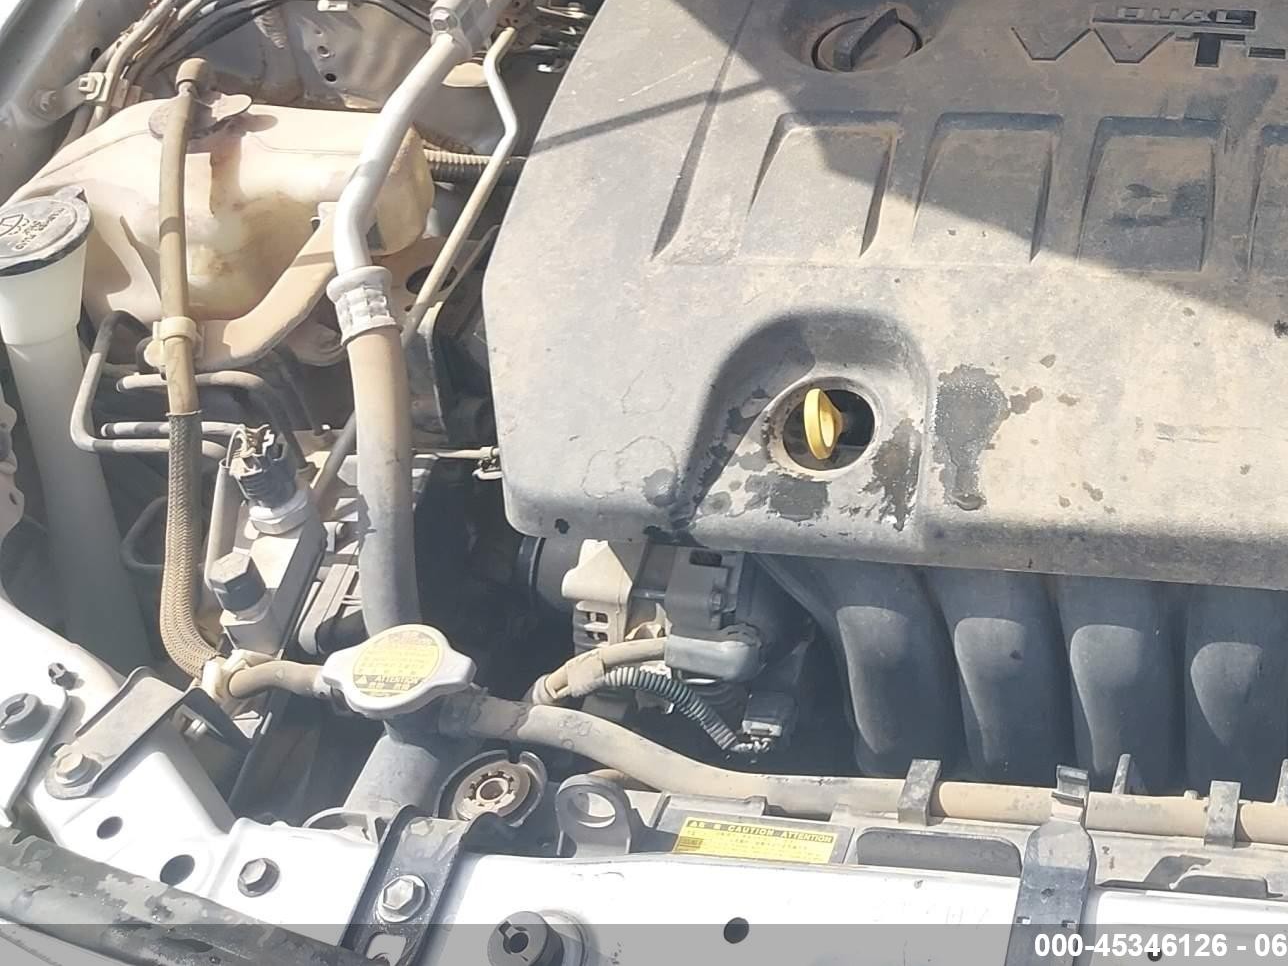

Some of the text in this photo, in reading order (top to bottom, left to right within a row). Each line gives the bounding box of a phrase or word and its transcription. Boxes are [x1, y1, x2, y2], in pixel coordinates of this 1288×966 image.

[1117, 6, 1243, 25] DUAL
[727, 824, 774, 837] CAUTION
[781, 831, 834, 844] ATTENTION
